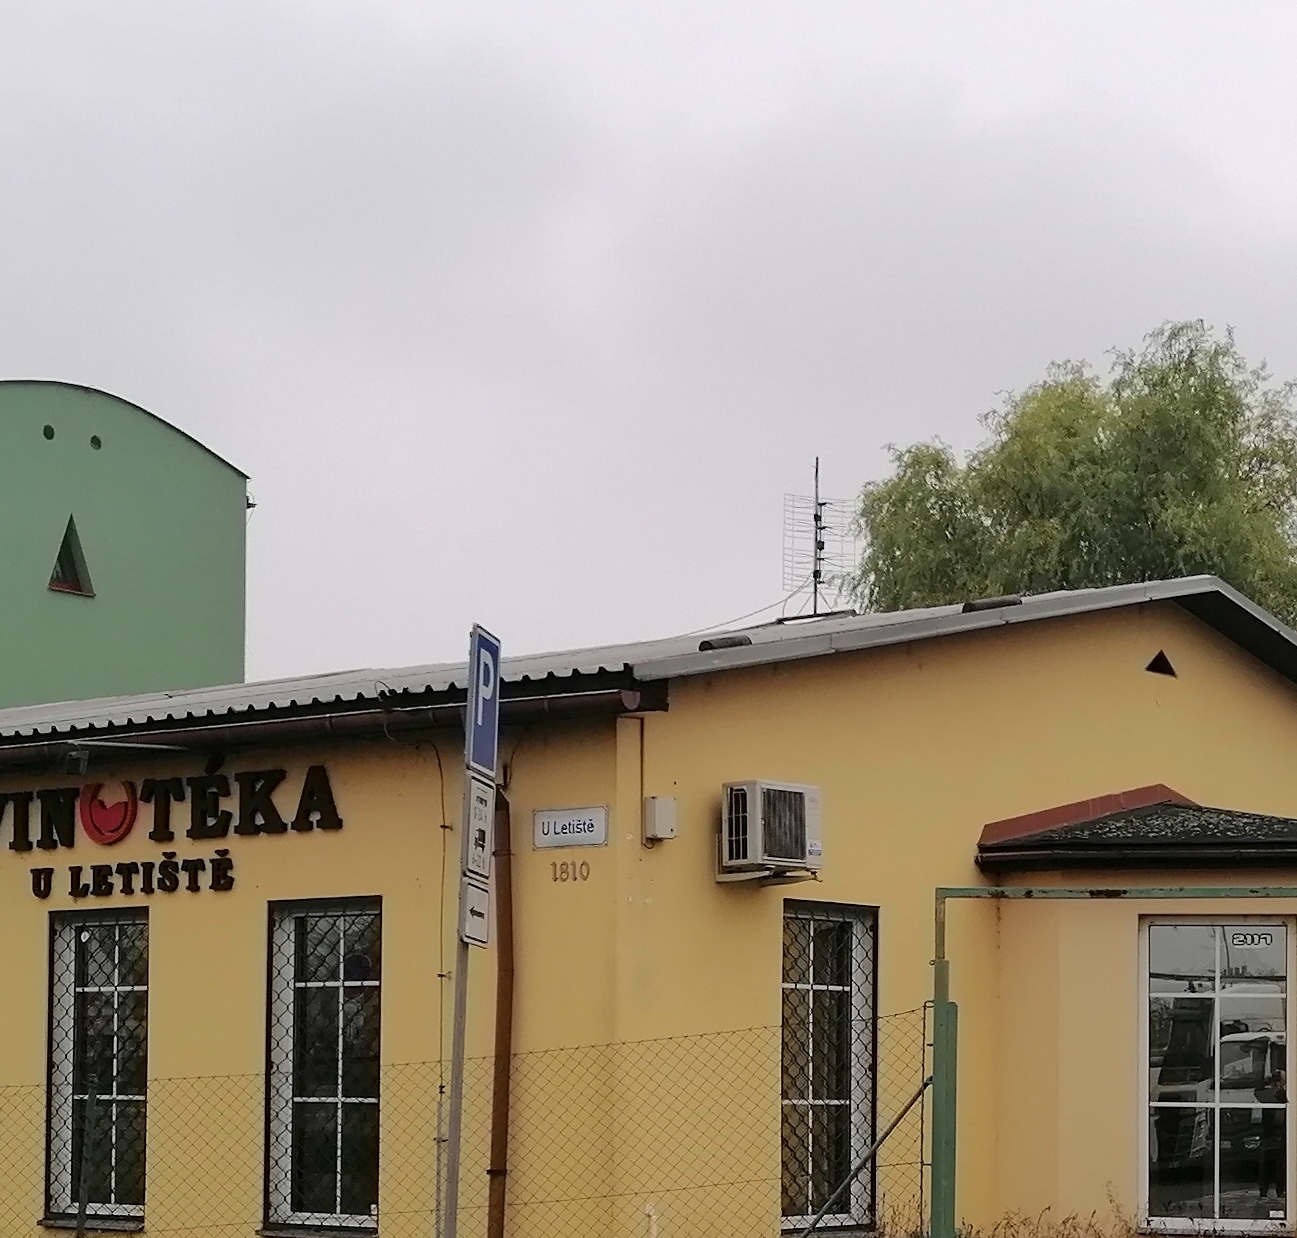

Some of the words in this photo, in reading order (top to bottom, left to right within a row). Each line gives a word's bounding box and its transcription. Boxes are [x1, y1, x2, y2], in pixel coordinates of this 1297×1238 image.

[477, 648, 494, 725] P
[542, 821, 550, 836] U
[553, 818, 595, 835] Letiště
[29, 866, 54, 899] U
[68, 849, 235, 899] LETIŠTĚ
[550, 859, 590, 882] 1810
